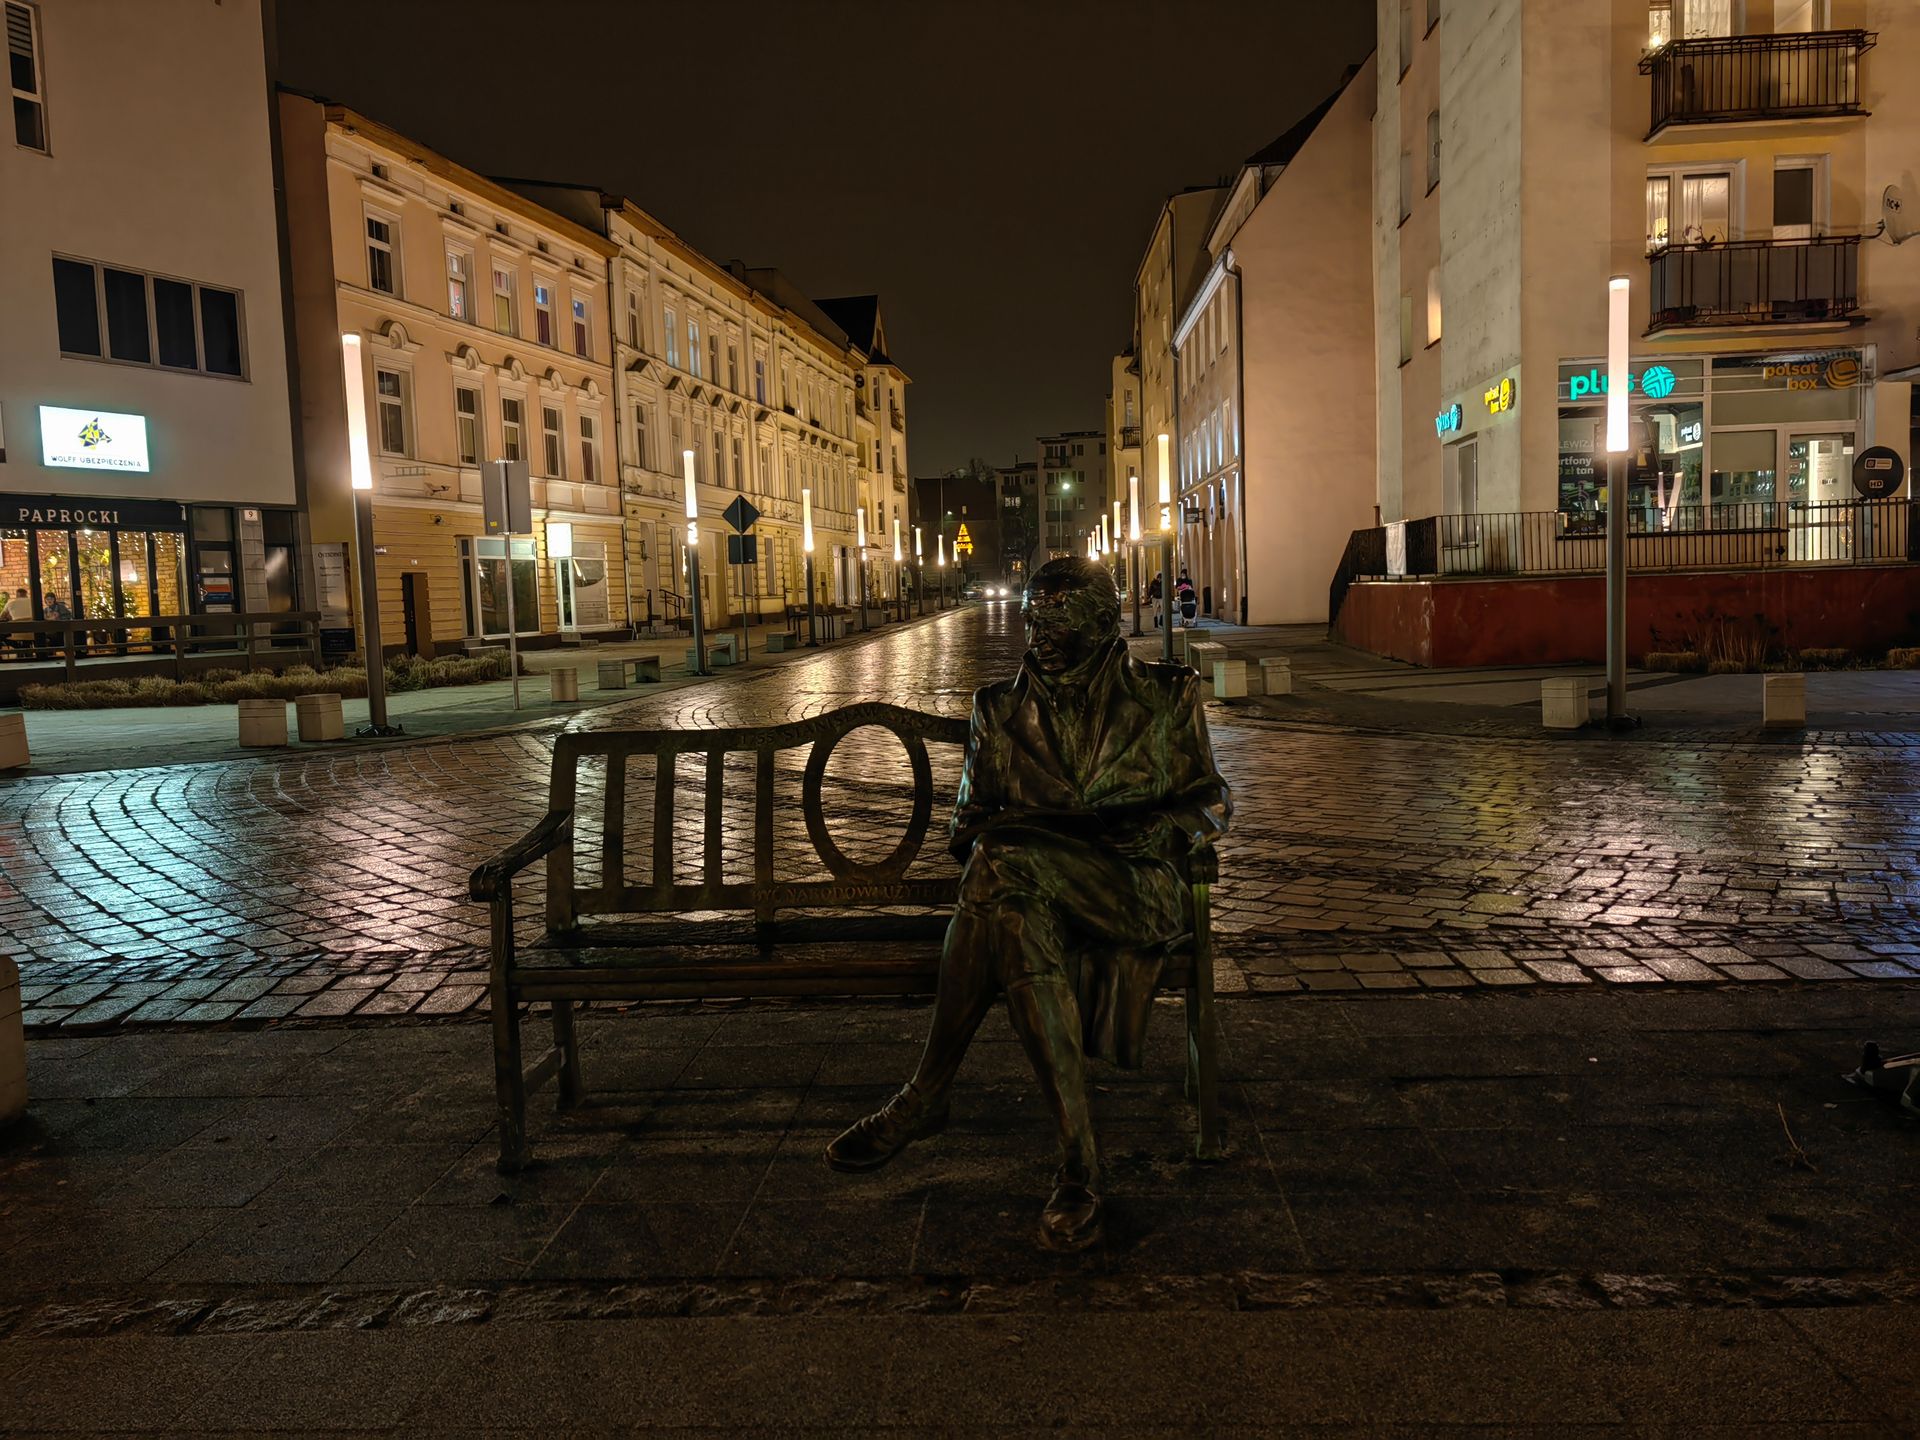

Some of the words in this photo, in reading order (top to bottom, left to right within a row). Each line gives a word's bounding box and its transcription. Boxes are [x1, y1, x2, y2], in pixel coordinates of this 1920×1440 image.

[1763, 362, 1819, 380] polsat
[1787, 378, 1818, 391] box
[1435, 411, 1450, 438] plus
[50, 455, 77, 464] WOLFF
[80, 456, 142, 468] UBEZPIECZENIA
[1870, 480, 1883, 488] HD
[18, 507, 120, 524] PAPROCKI
[248, 510, 255, 519] 9
